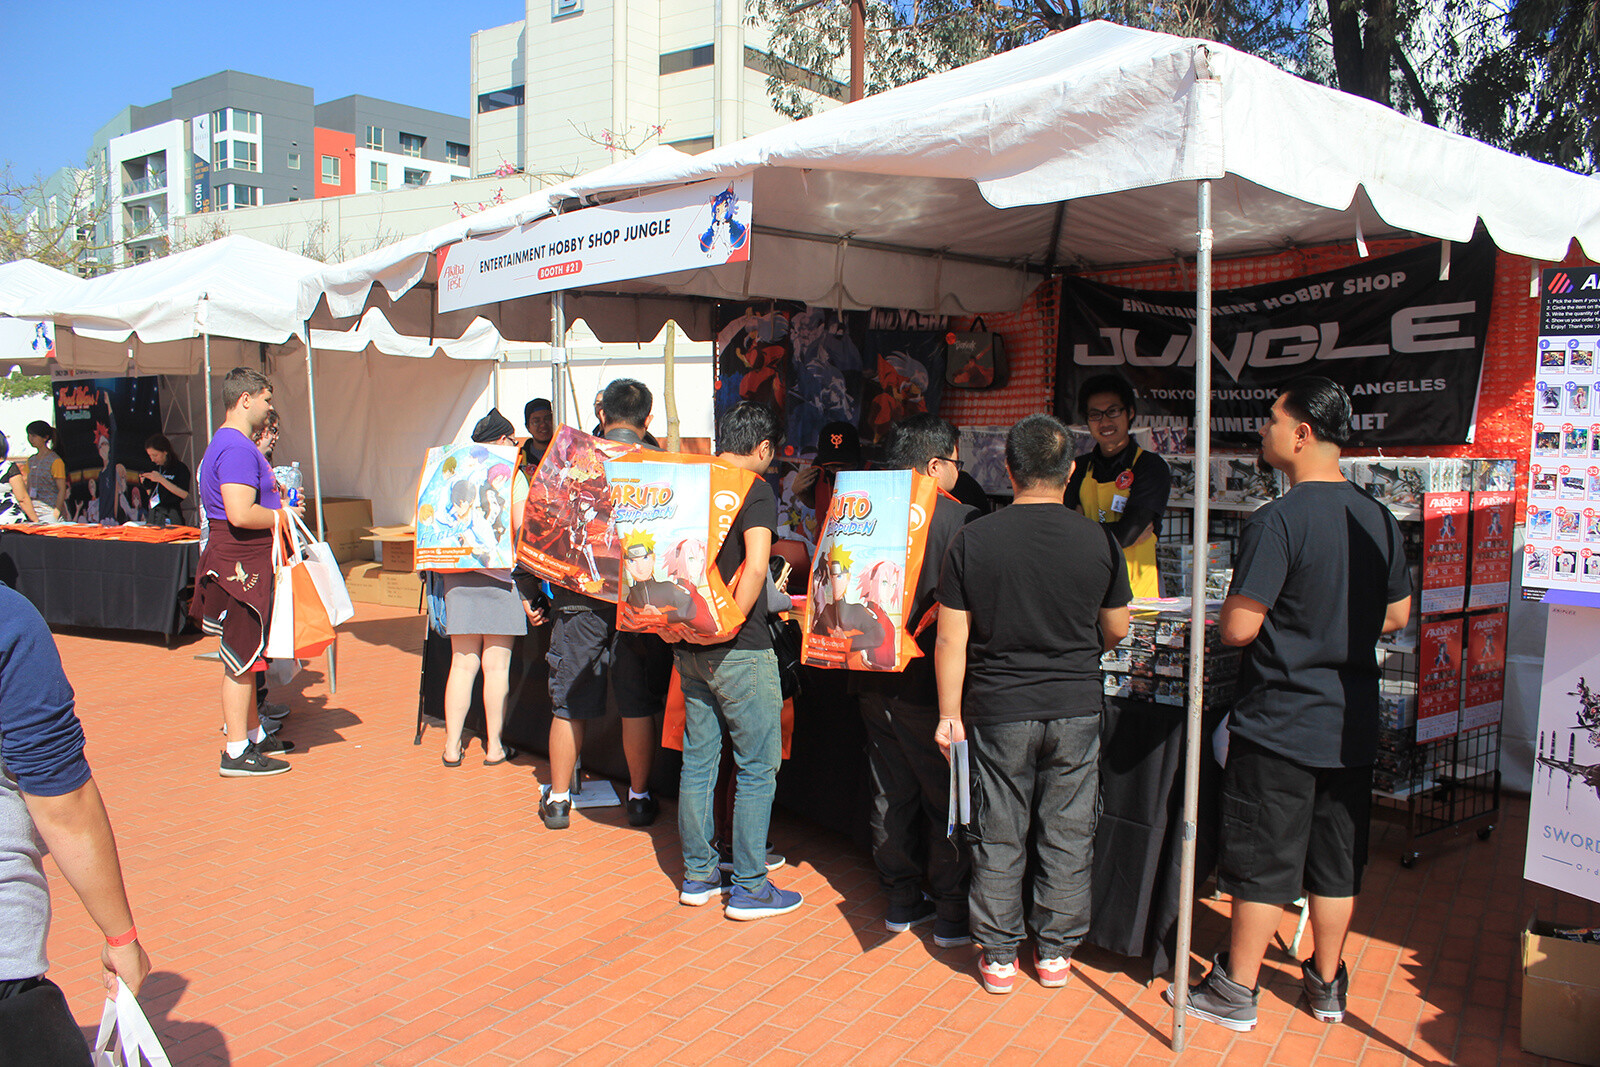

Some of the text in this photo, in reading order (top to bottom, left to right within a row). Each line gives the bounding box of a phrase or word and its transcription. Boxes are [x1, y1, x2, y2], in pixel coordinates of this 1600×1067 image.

[480, 218, 671, 274] ENTERTAINMENT HOBBY SHOP JUNGLE
[540, 262, 580, 279] BOOTH #21
[1264, 282, 1332, 311] HOBBY
[1342, 272, 1407, 296] SHOP
[1073, 300, 1476, 383] JUNGLE
[1150, 388, 1196, 400] TOKYO
[1210, 388, 1280, 400] FUKUOK
[1352, 378, 1447, 396] ANGELES
[608, 484, 672, 510] ARUTO
[1543, 824, 1600, 854] SWORD
